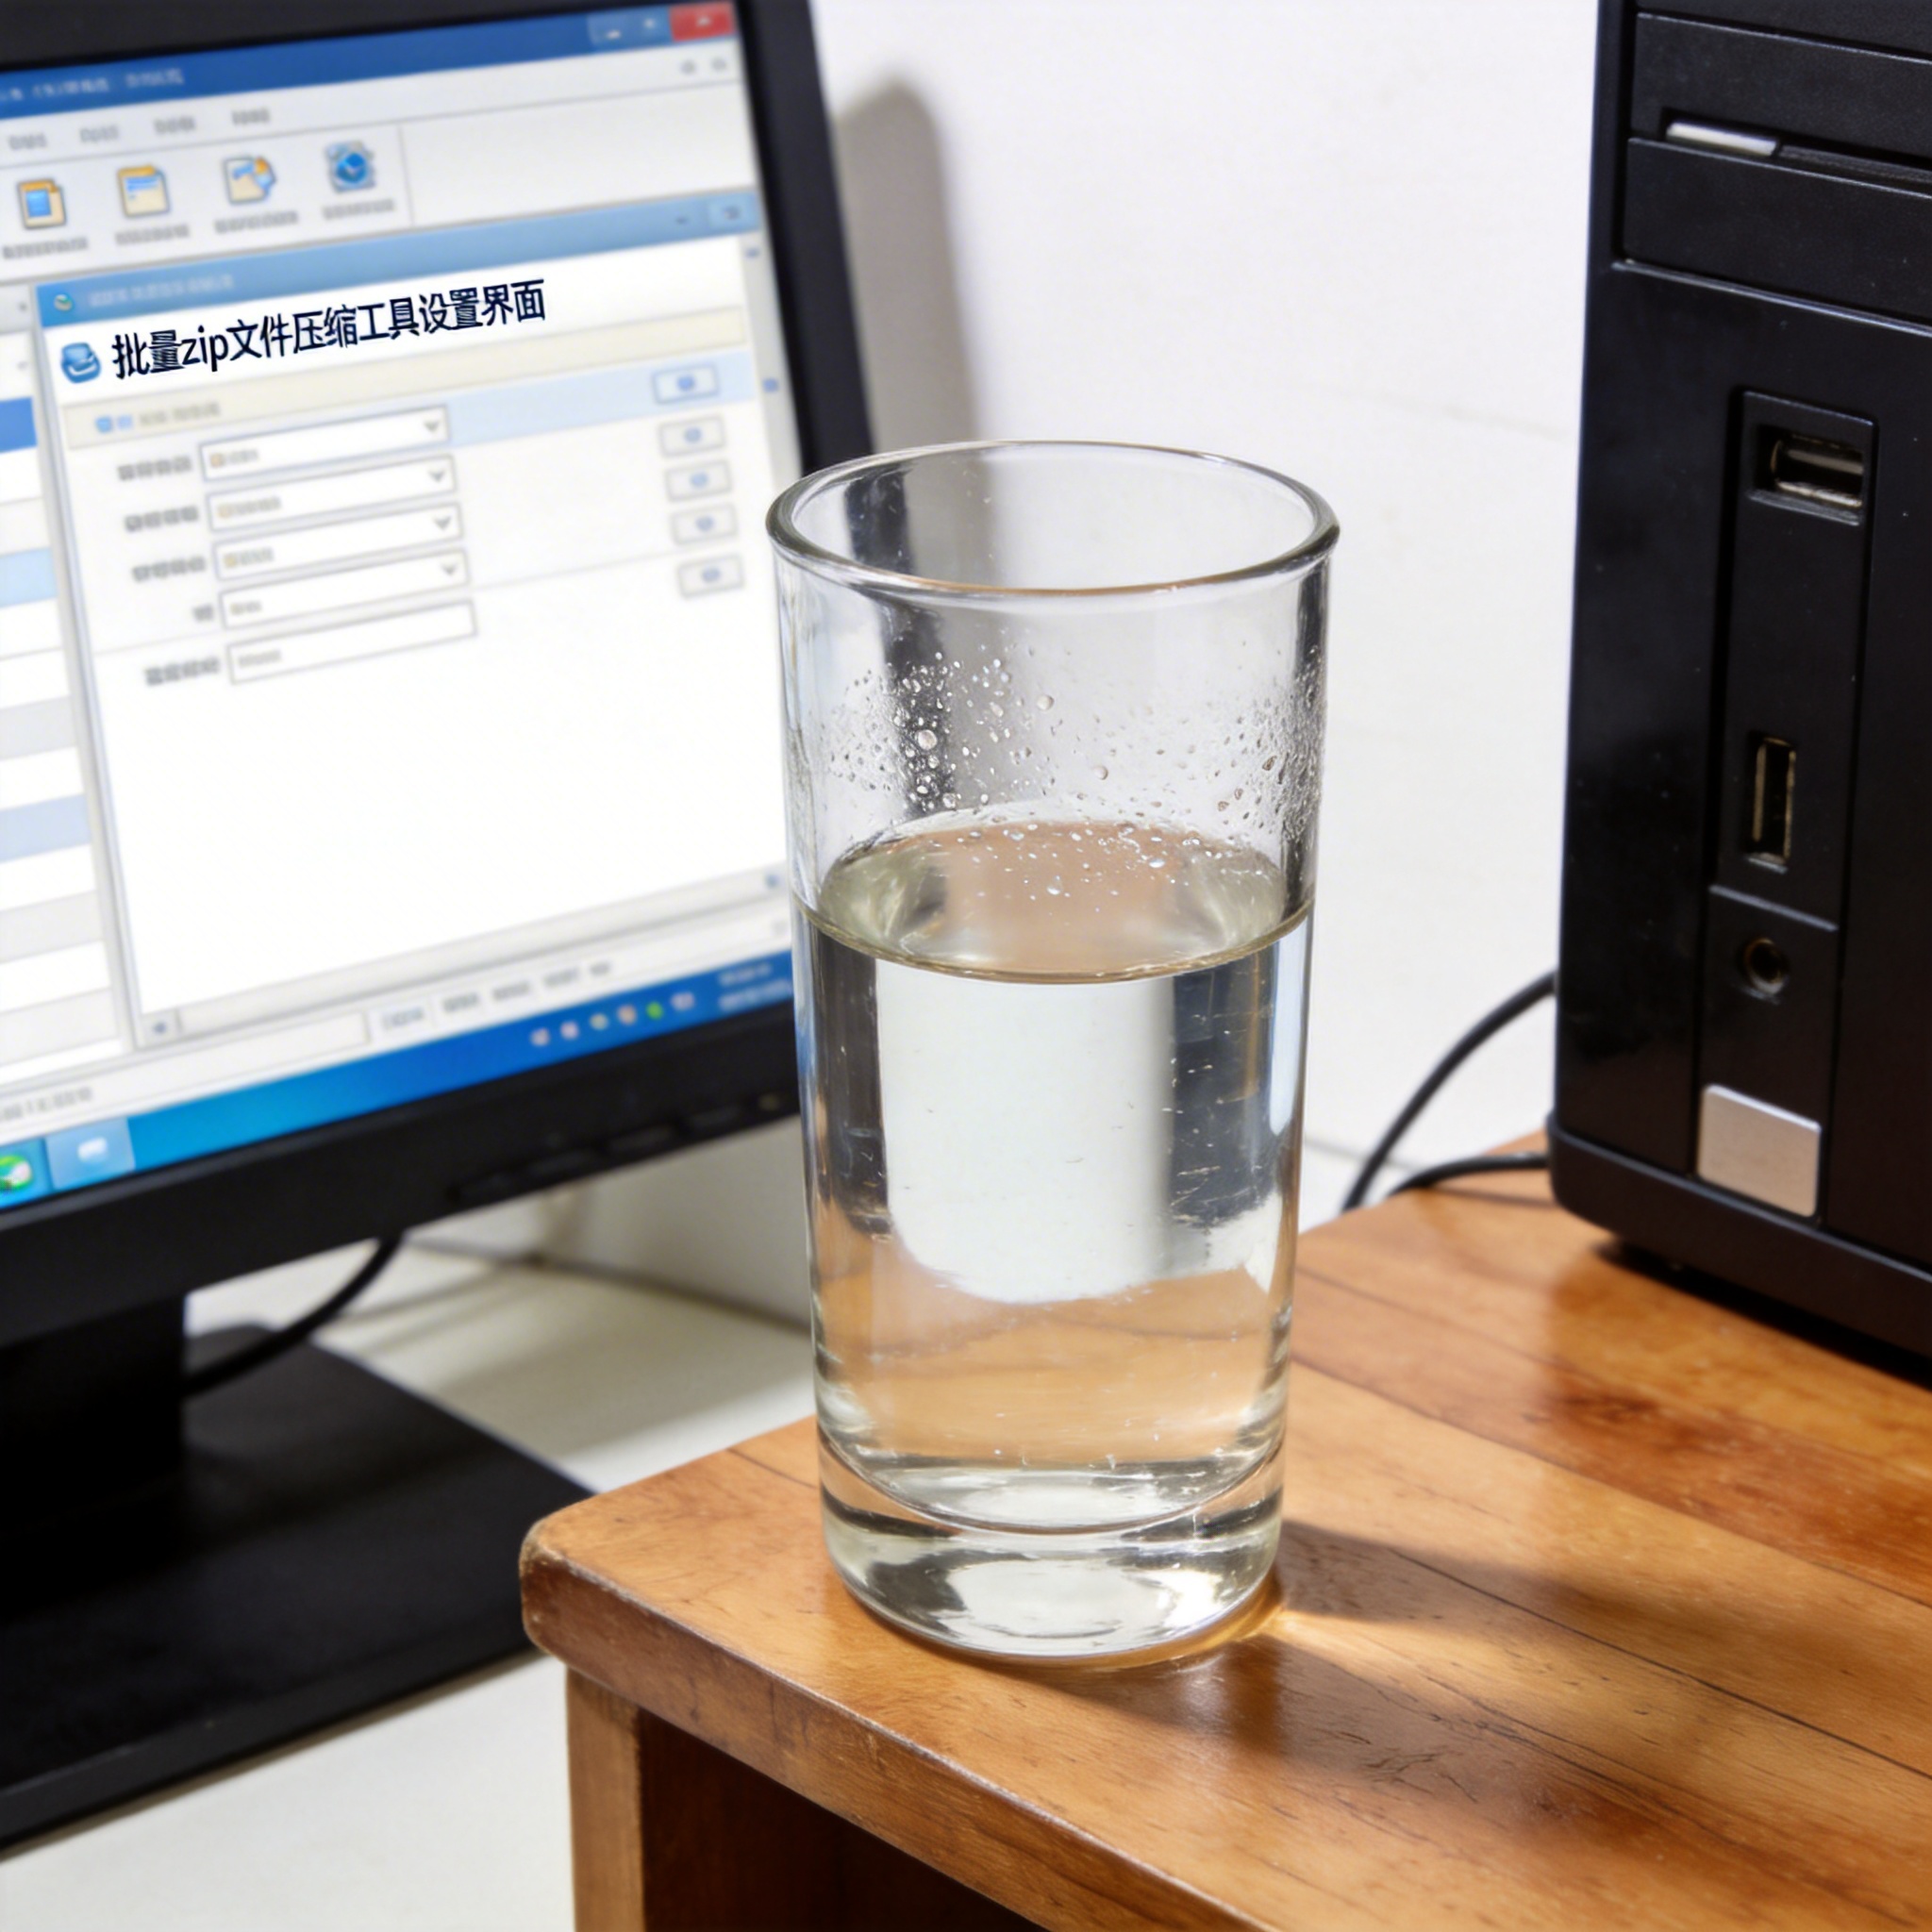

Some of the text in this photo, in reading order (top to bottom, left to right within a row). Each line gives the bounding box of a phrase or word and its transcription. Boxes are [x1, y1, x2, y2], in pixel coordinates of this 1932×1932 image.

[112, 279, 545, 379] 批量zip文件压缩工具设置界面
